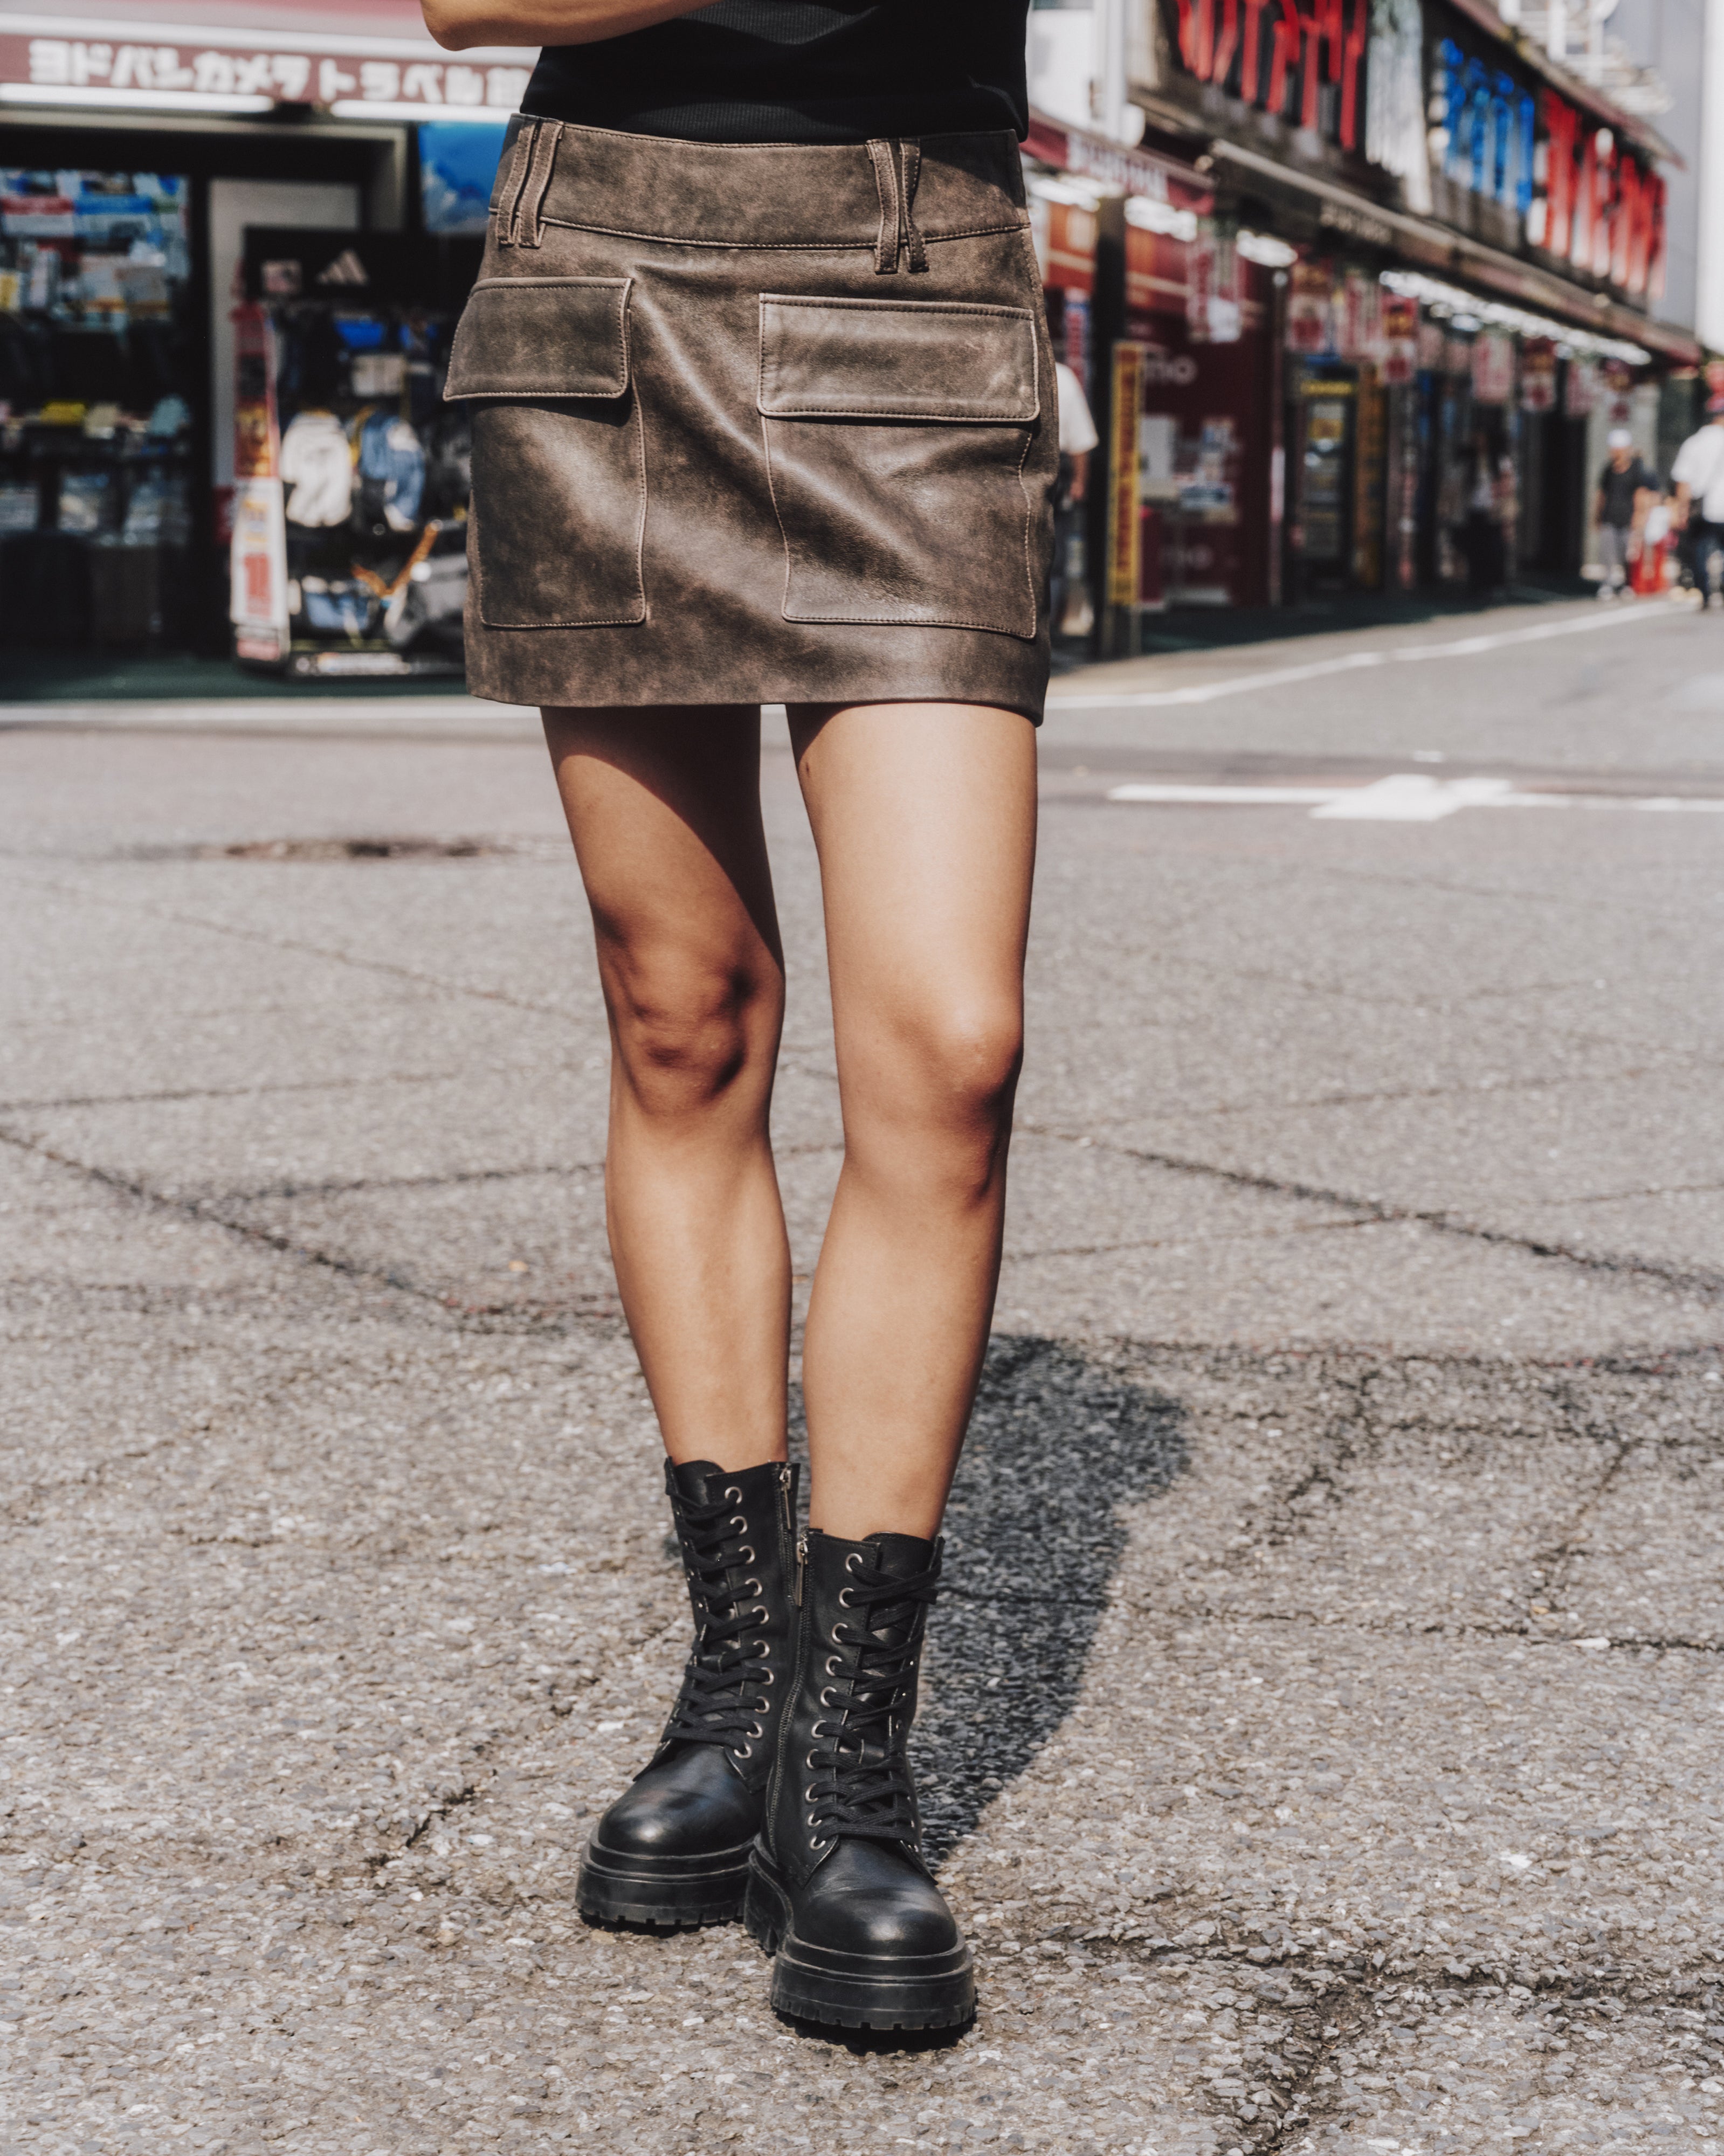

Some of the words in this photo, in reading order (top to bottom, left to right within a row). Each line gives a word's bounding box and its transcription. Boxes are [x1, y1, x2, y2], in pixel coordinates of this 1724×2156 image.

[29, 39, 311, 99] ヨドバシカメラ
